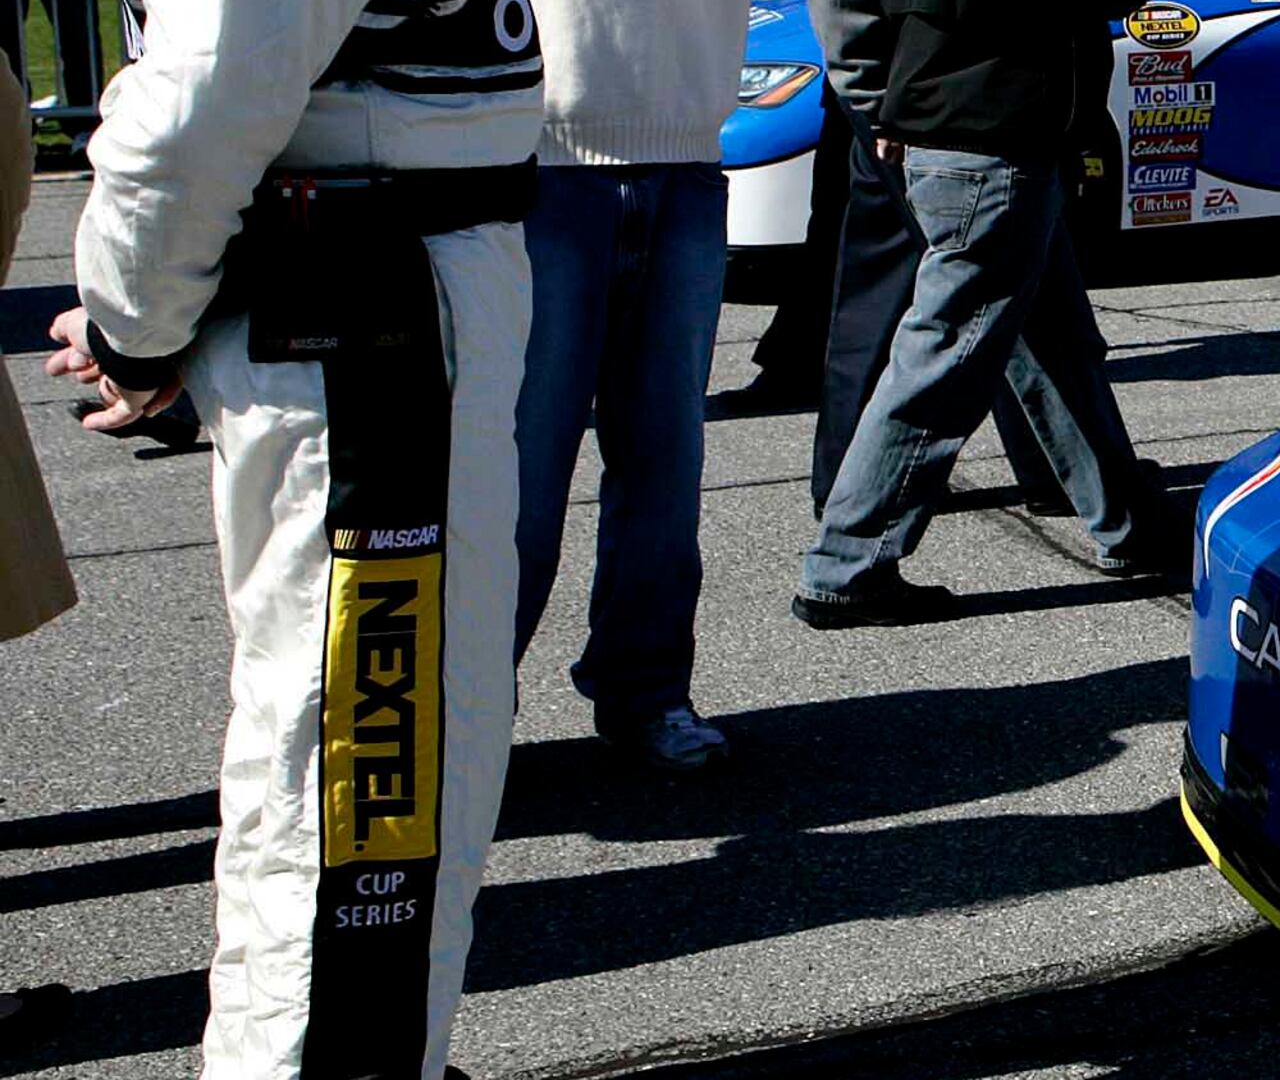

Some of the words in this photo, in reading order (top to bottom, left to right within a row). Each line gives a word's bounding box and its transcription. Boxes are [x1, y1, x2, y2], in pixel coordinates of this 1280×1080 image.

[1140, 21, 1186, 32] NEXTEL
[1129, 53, 1188, 76] Bud
[1134, 84, 1188, 105] Mobil
[1131, 105, 1212, 128] MOOG
[1131, 139, 1199, 158] Edelbrock
[1133, 166, 1191, 185] CLEVITE
[1203, 188, 1239, 208] EA
[367, 524, 438, 550] NASCAR
[353, 579, 419, 842] NEXTEL
[355, 872, 406, 897] CUP
[335, 899, 418, 929] SERIES
